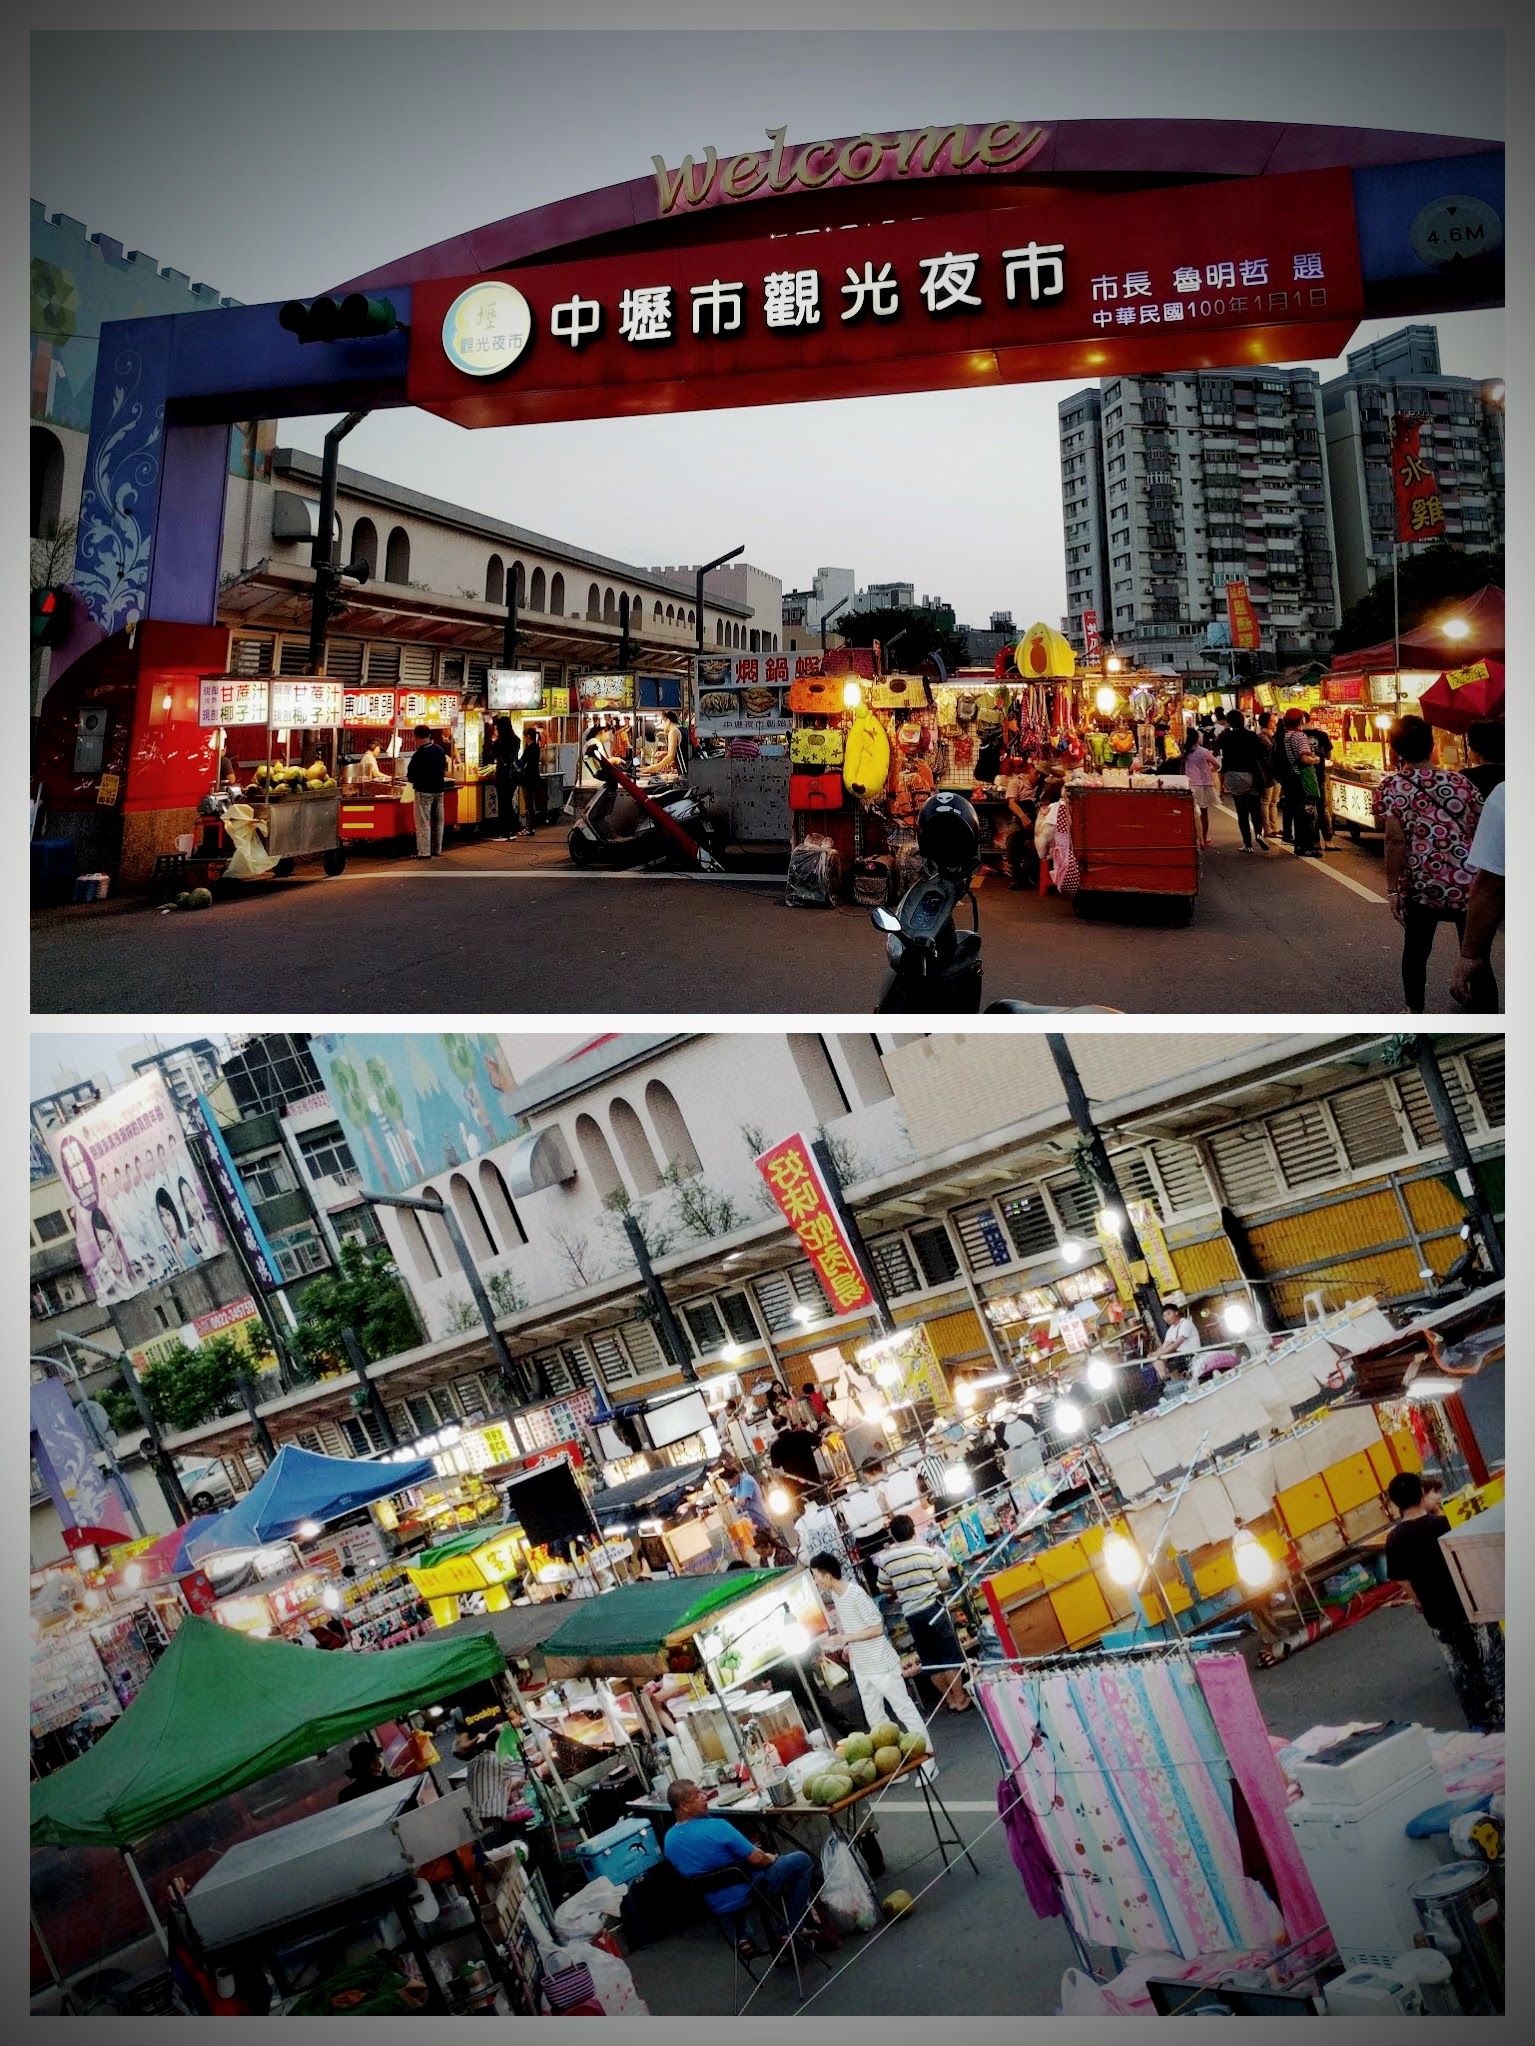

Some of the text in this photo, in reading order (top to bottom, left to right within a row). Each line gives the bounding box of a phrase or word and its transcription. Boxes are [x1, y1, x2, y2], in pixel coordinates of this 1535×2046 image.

[651, 121, 1041, 215] Welcome
[1426, 224, 1485, 245] 4.6M
[1091, 252, 1325, 301] 市長 魯明哲 題
[550, 241, 1066, 348] 中壢市觀光夜市
[1092, 288, 1327, 329] 中華民國100年1月1日
[460, 333, 523, 355] 觀光夜市
[221, 683, 266, 702] 甘蔗汁
[294, 684, 340, 702] 甘蔗汁
[220, 704, 266, 723] 椰子汁
[293, 706, 340, 724] 椰子汁
[210, 1299, 255, 1330] 0922-345759
[464, 1705, 501, 1726] Brooklyn
